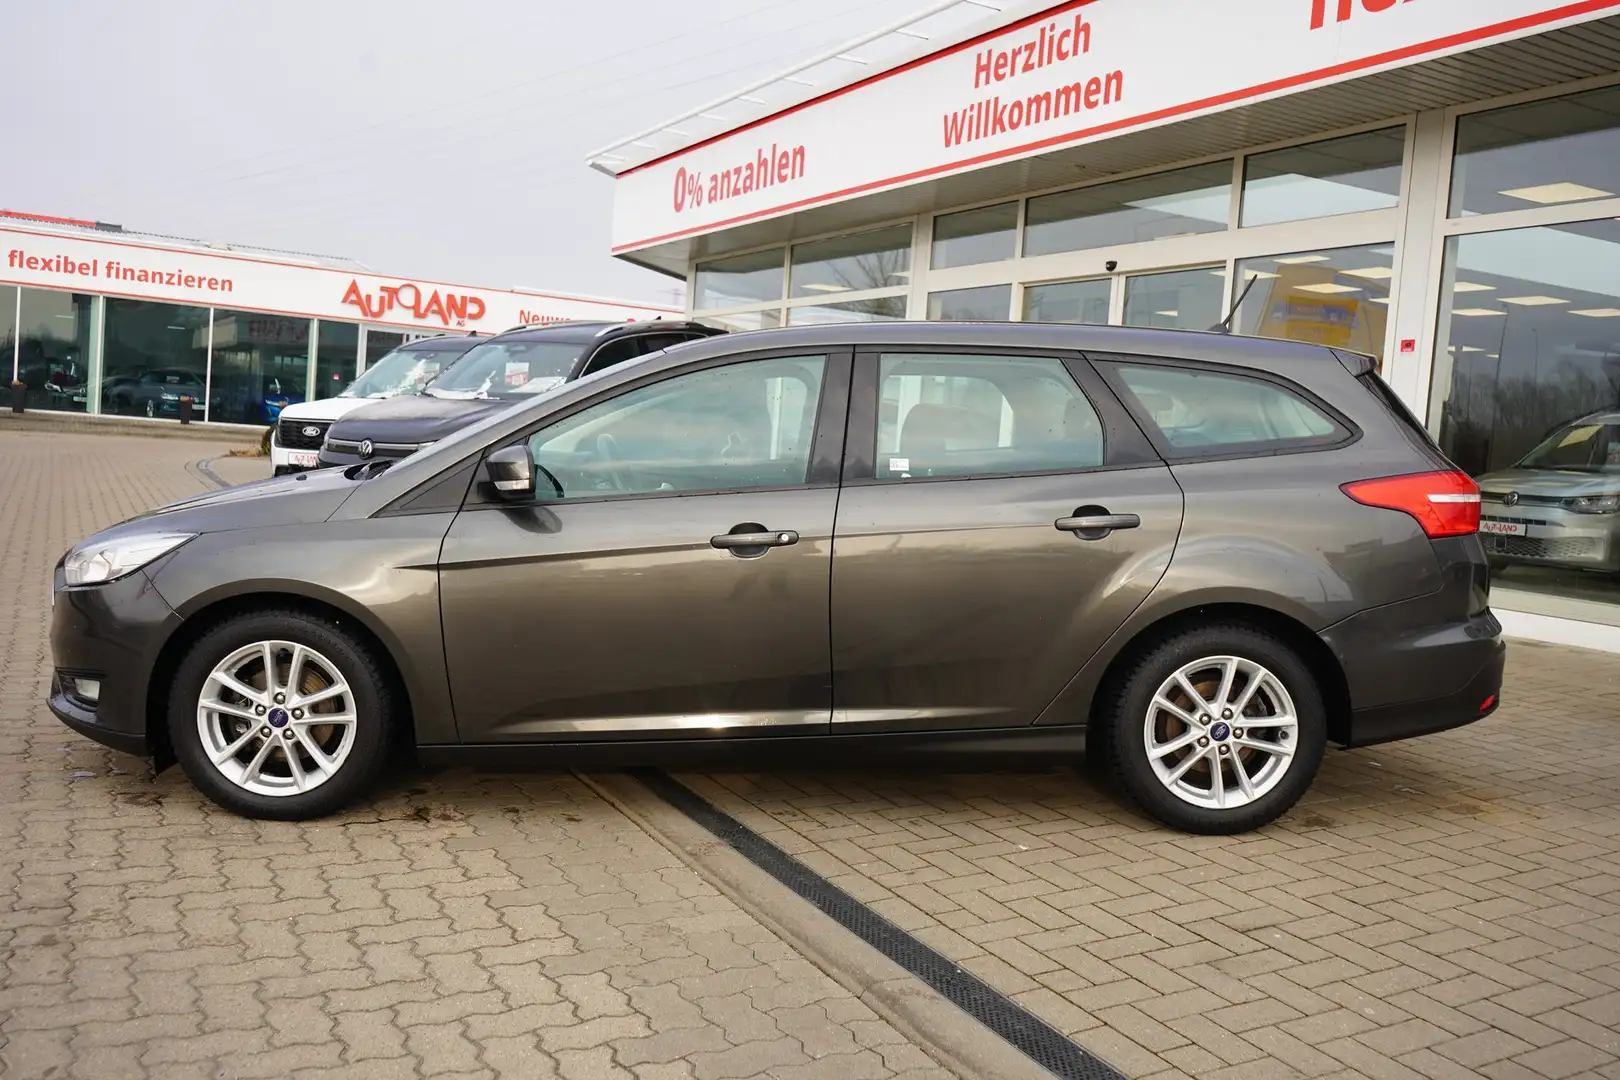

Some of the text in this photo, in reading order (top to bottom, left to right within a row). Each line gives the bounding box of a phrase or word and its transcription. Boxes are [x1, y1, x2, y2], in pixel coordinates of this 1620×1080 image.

[974, 15, 1091, 89] Herzlich
[943, 69, 1124, 148] Willkommen
[673, 144, 806, 212] 0% anzahlen
[8, 249, 234, 293] flexibel finanzieren
